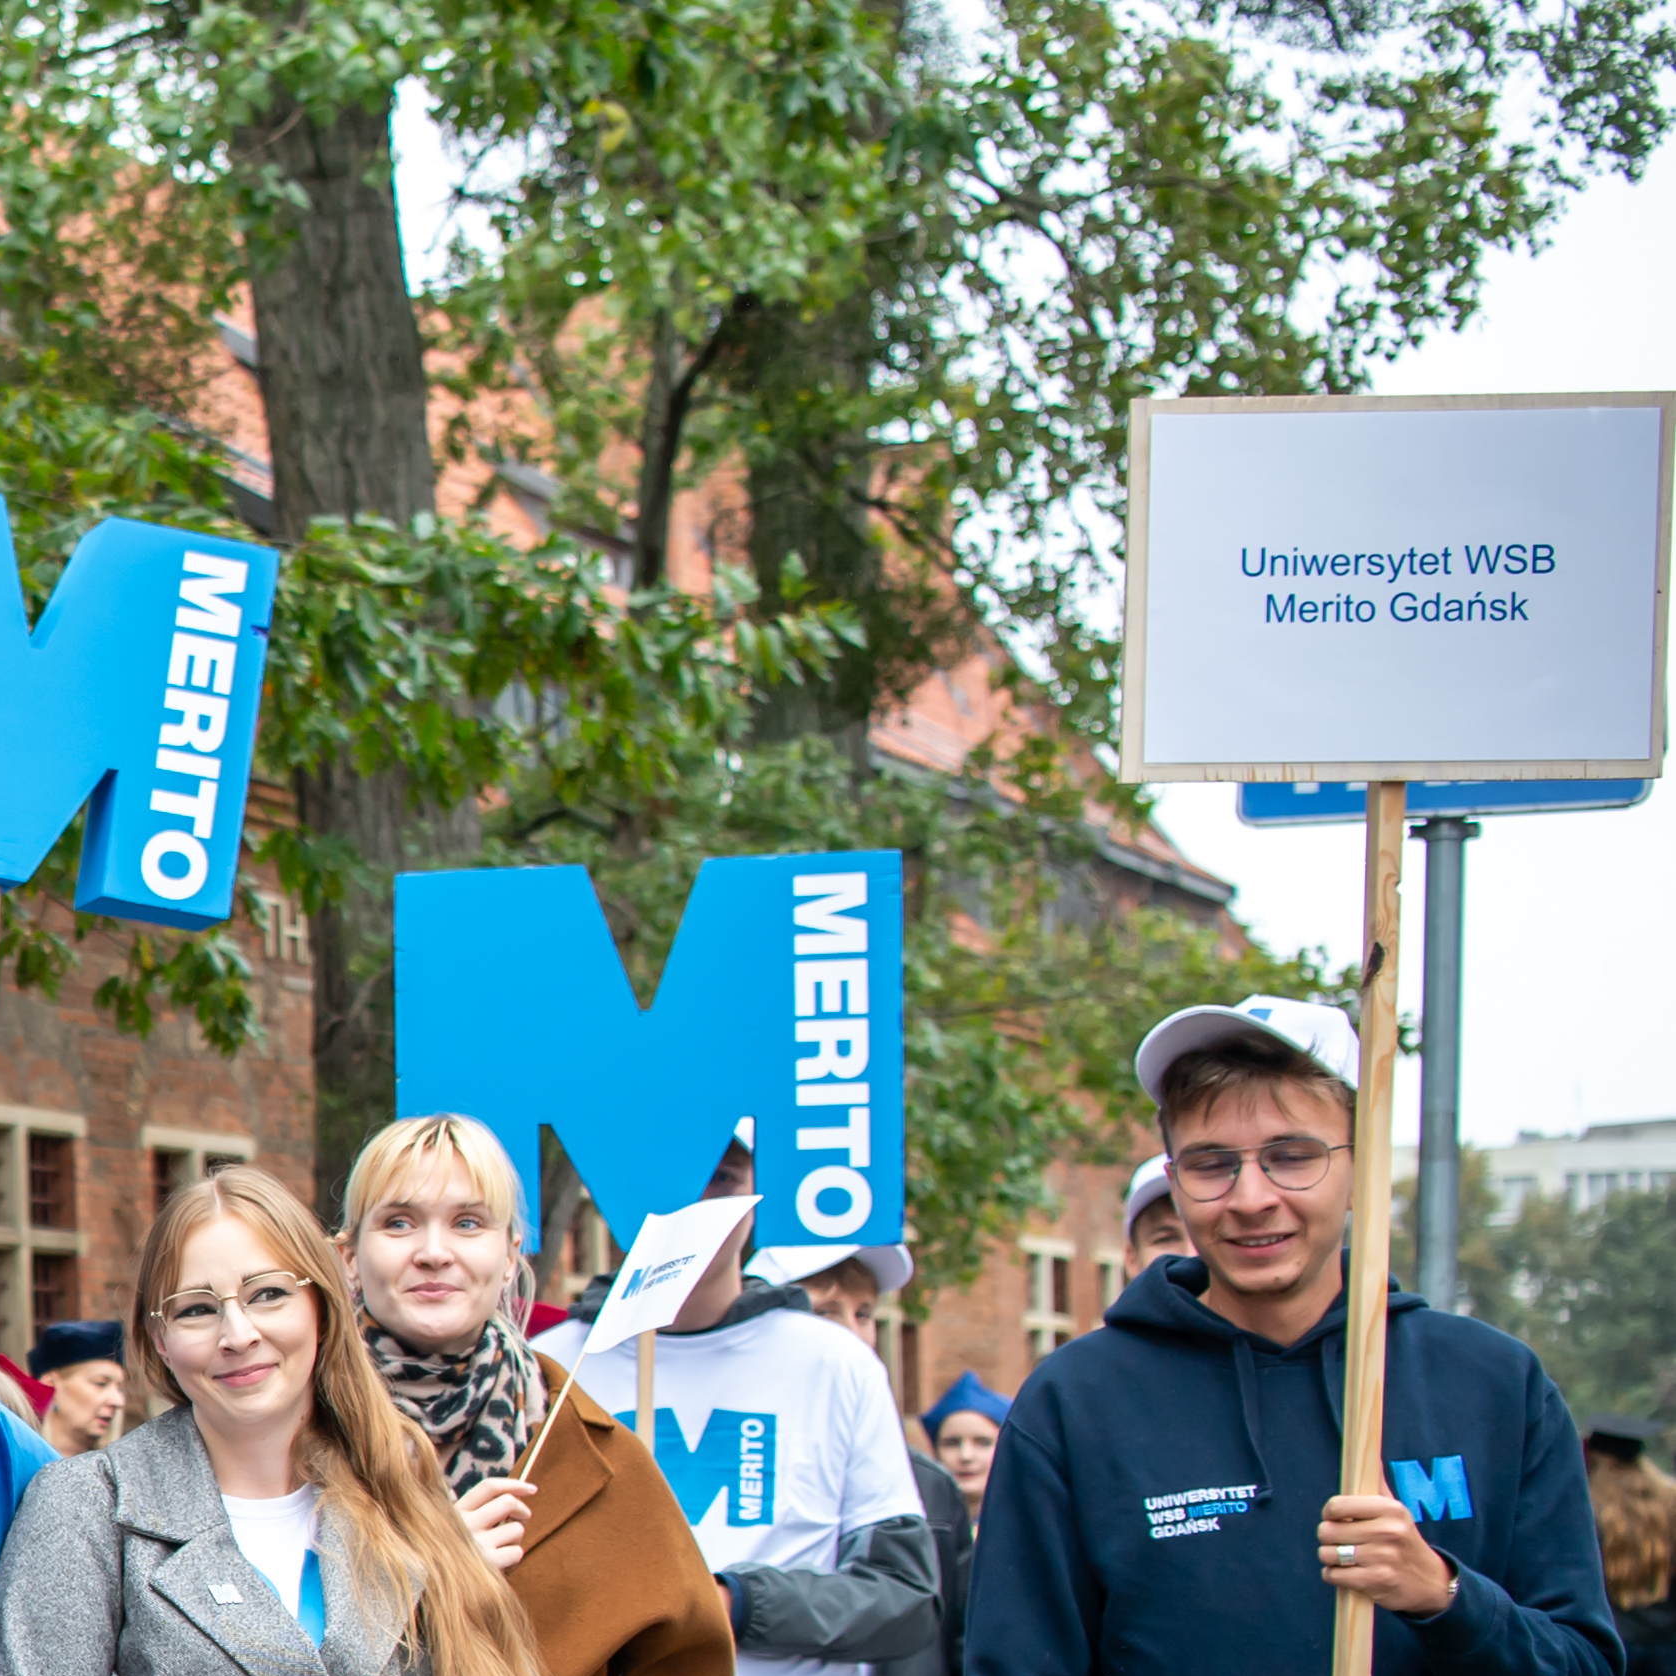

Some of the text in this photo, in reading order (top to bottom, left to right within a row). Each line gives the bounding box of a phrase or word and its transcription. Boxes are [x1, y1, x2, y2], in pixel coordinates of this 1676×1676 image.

[1240, 543, 1557, 584] Uniwersytet WSB
[1264, 591, 1530, 625] Merito Gdańsk
[140, 550, 248, 900] MERITO
[792, 871, 873, 1238] MERITO
[739, 1418, 765, 1520] MERITO
[1144, 1484, 1258, 1511] UNIWERSYTET
[1147, 1500, 1249, 1525] WSB MERITO
[1149, 1516, 1221, 1539] GDAŃSK
